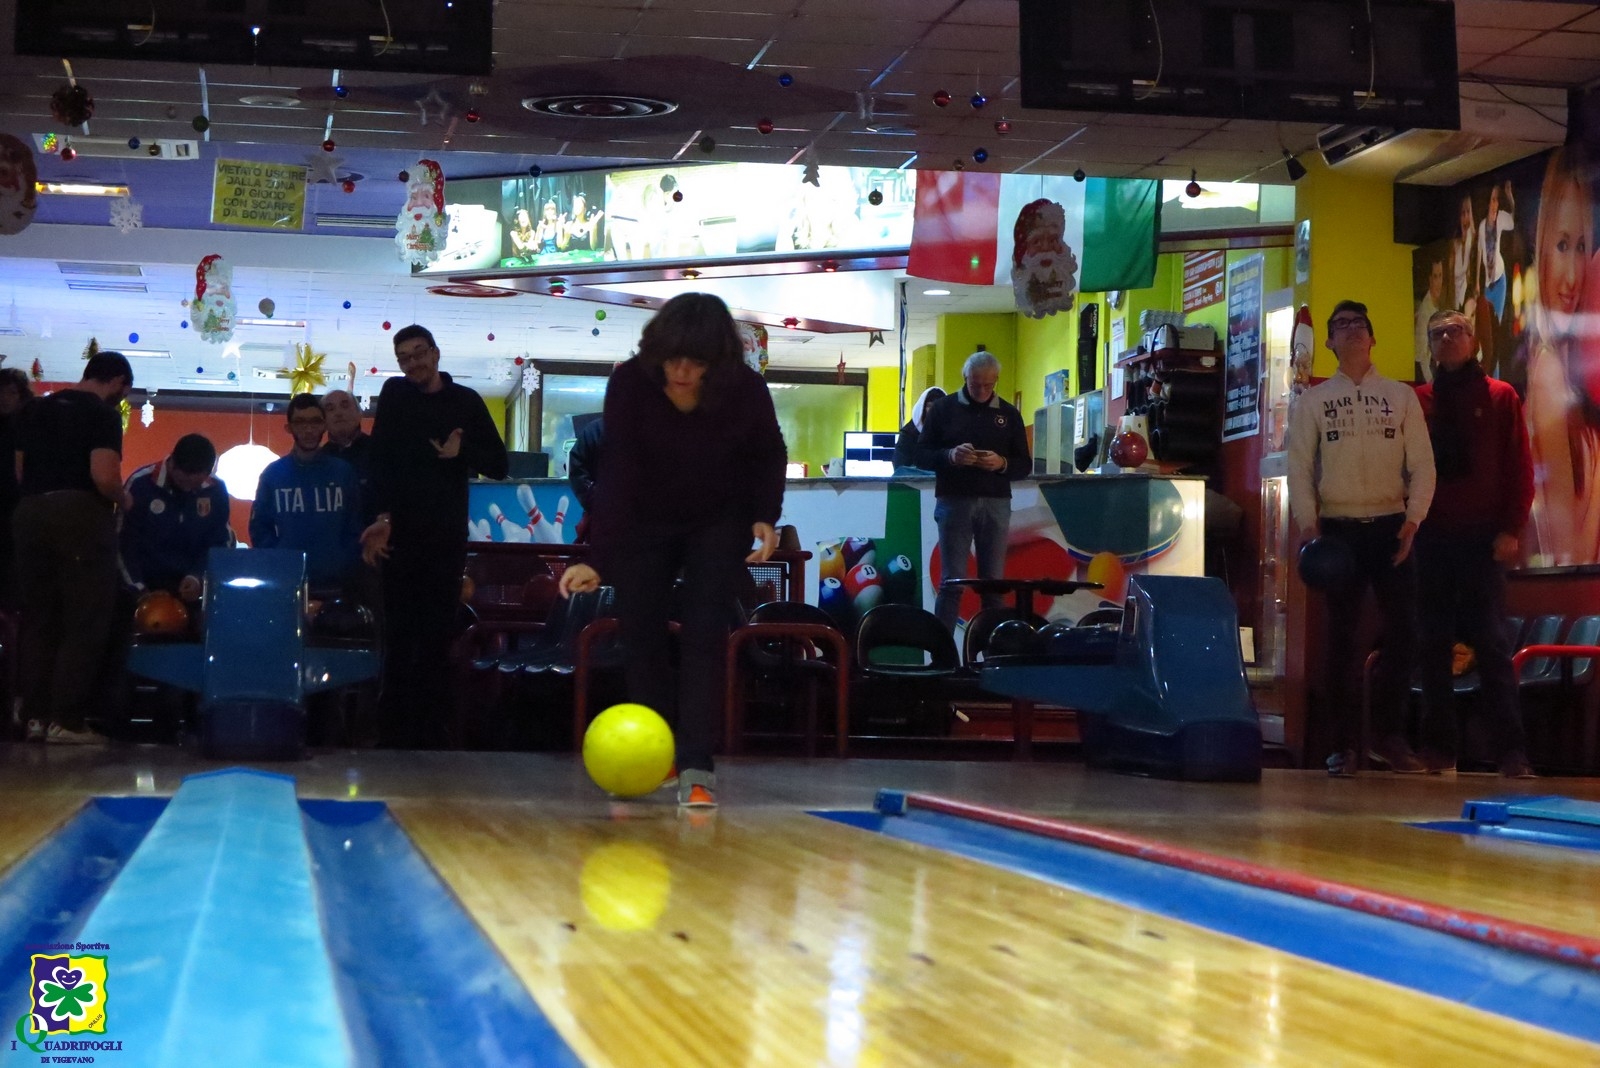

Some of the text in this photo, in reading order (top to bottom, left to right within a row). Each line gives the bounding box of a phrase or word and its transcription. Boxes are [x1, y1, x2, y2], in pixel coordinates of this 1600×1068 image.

[217, 165, 307, 181] VIETATO USCIRE
[226, 176, 295, 190] DALLA ZONA
[234, 187, 286, 200] DI GIOCO
[223, 198, 296, 212] CON SCARPE
[222, 208, 238, 217] DA
[864, 566, 875, 576] 11
